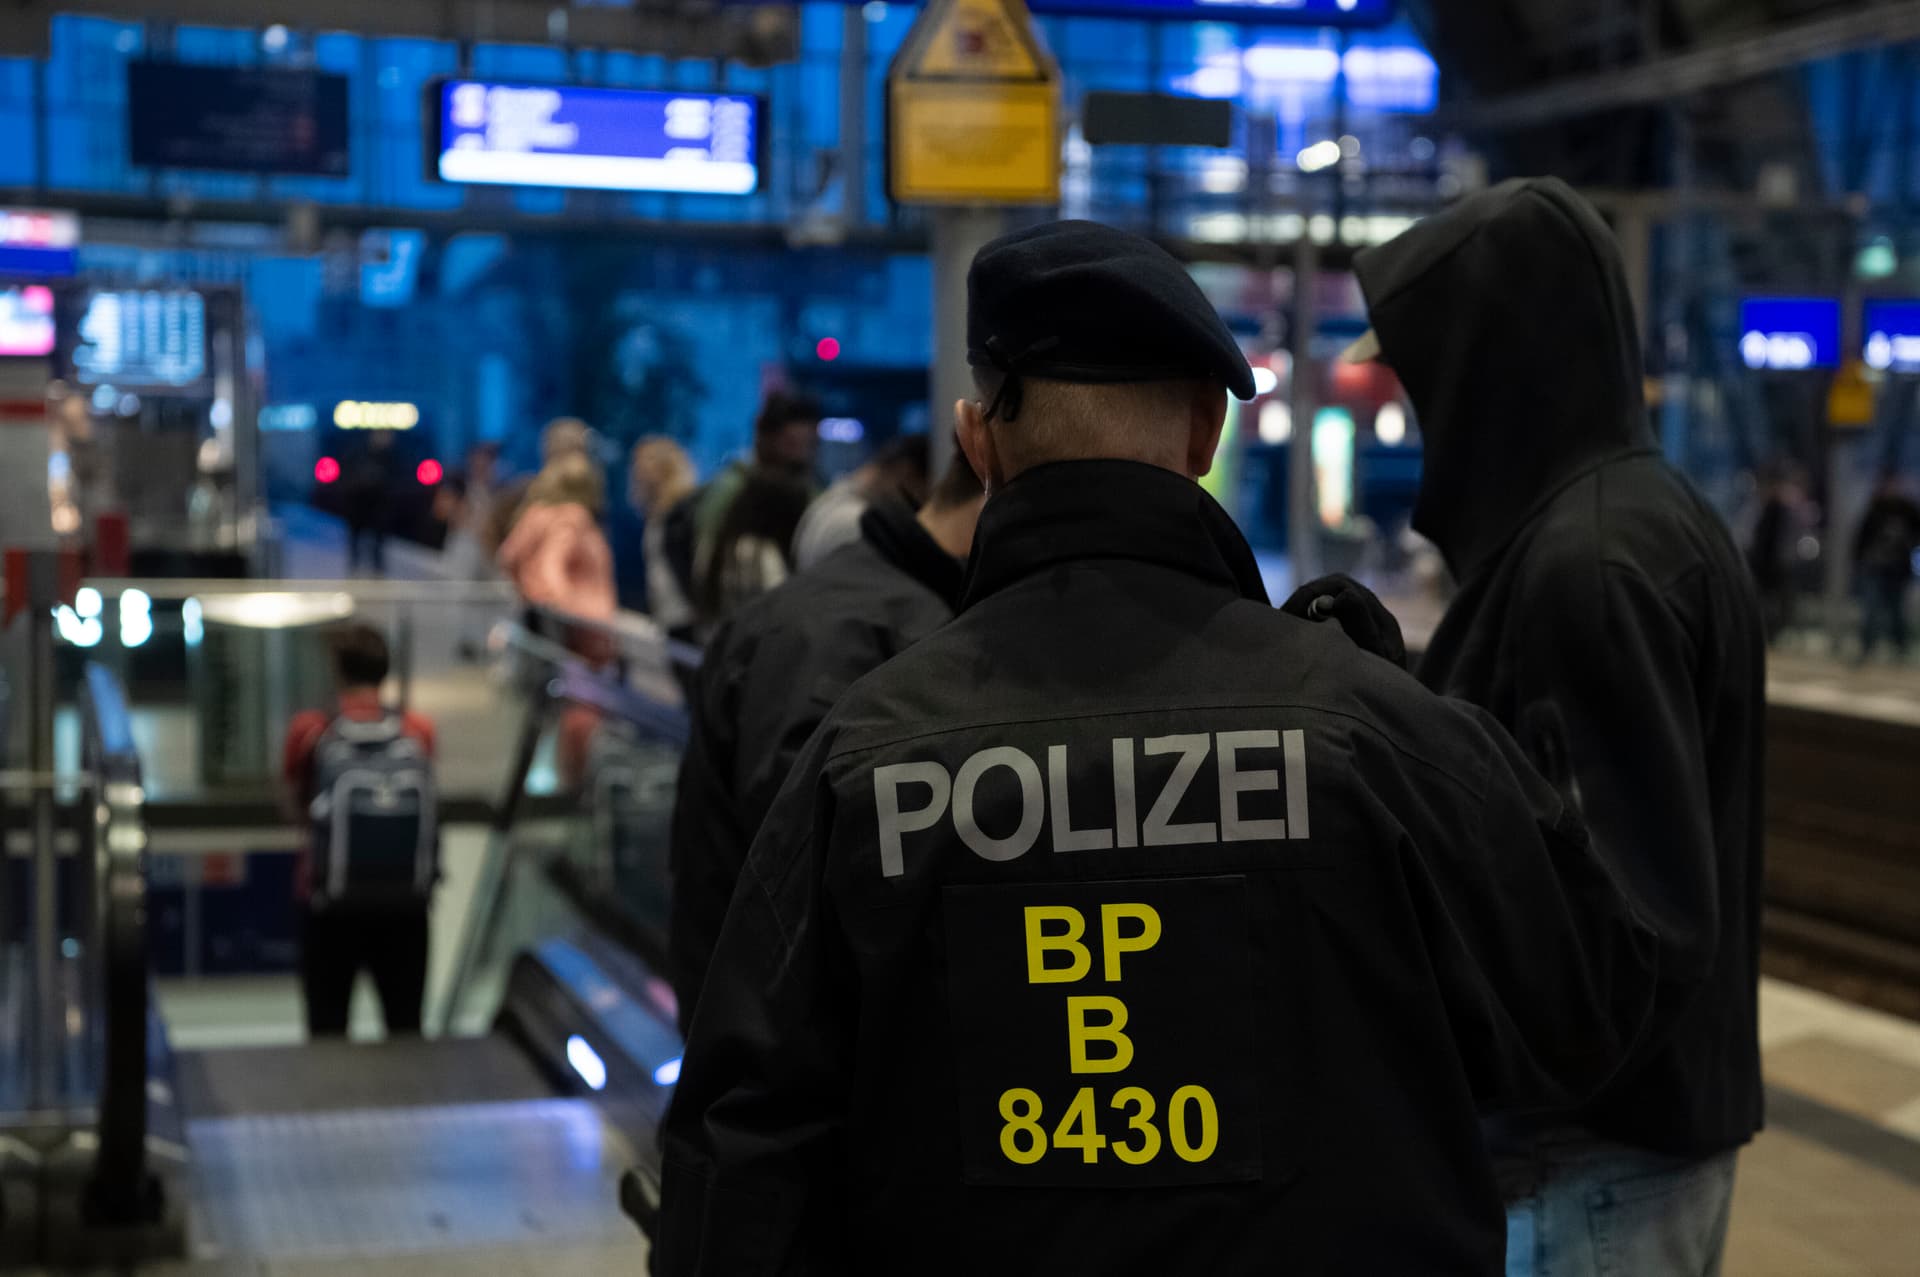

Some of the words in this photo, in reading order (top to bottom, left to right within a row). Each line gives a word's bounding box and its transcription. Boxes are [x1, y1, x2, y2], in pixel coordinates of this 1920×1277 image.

[873, 729, 1310, 878] POLIZEI
[1023, 902, 1163, 984] BP
[1066, 995, 1135, 1075] B
[998, 1084, 1220, 1166] 8430
